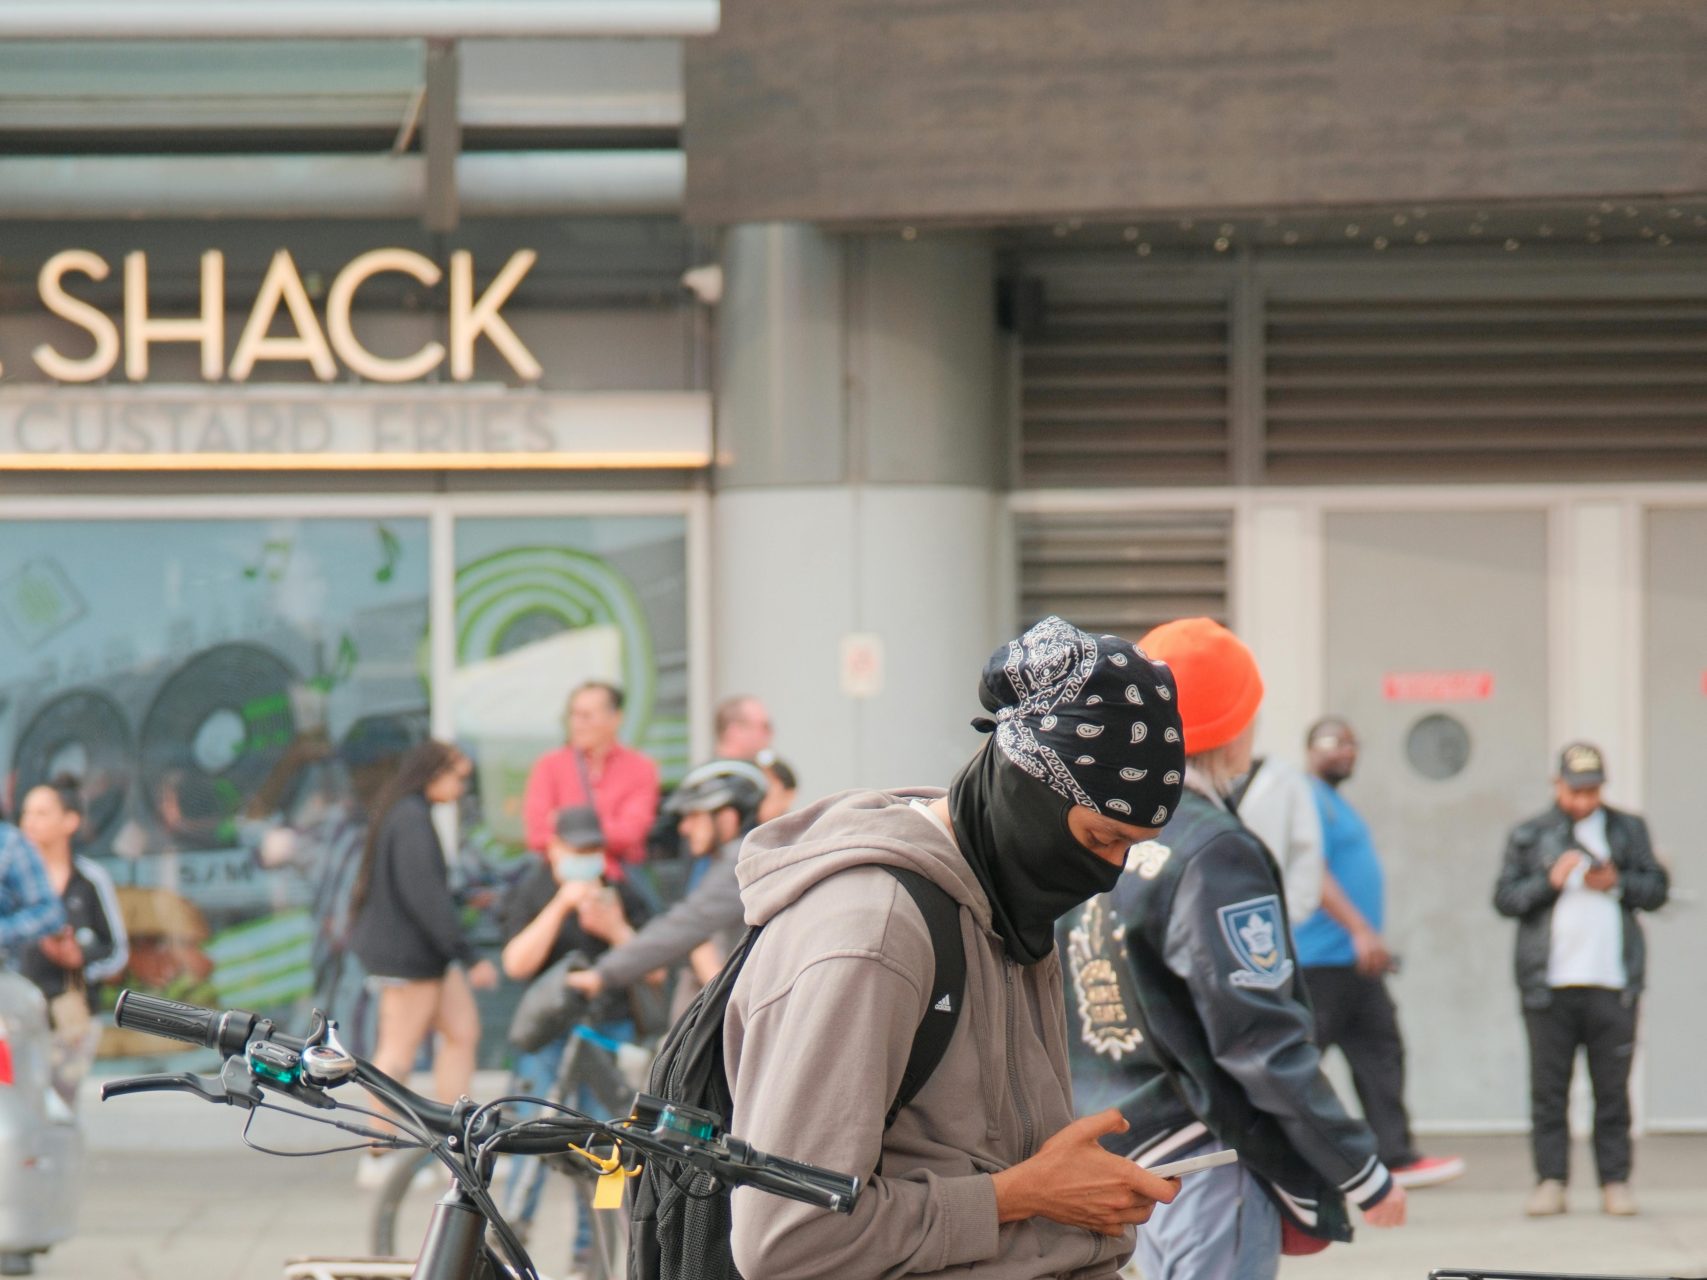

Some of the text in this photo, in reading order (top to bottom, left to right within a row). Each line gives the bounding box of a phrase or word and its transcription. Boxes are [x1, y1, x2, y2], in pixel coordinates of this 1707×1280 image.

[34, 248, 543, 381] SHACK
[14, 400, 557, 453] CUSTARD FRIES
